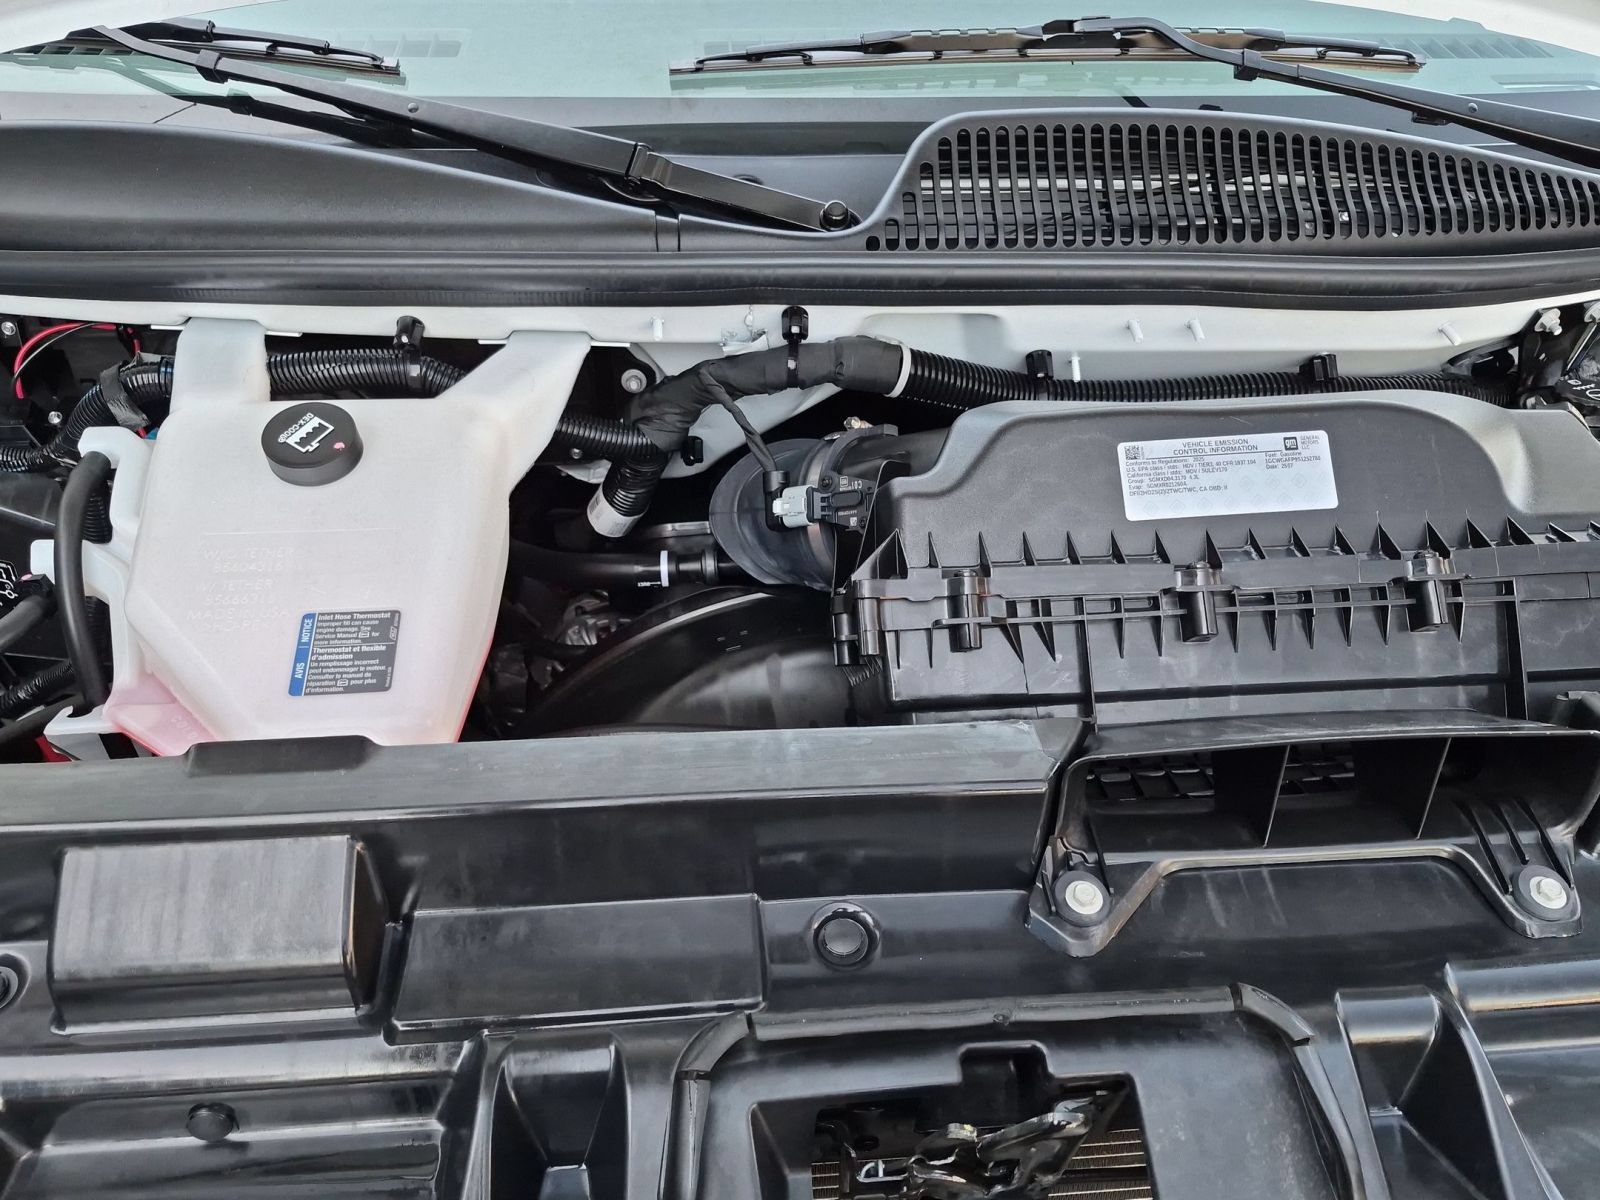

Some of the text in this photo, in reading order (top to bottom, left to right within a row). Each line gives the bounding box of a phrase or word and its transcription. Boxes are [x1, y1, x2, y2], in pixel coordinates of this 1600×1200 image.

[1210, 444, 1258, 453] INFORMATION
[1285, 439, 1296, 448] gm
[301, 618, 312, 643] NOTICE
[295, 662, 305, 679] AVIS
